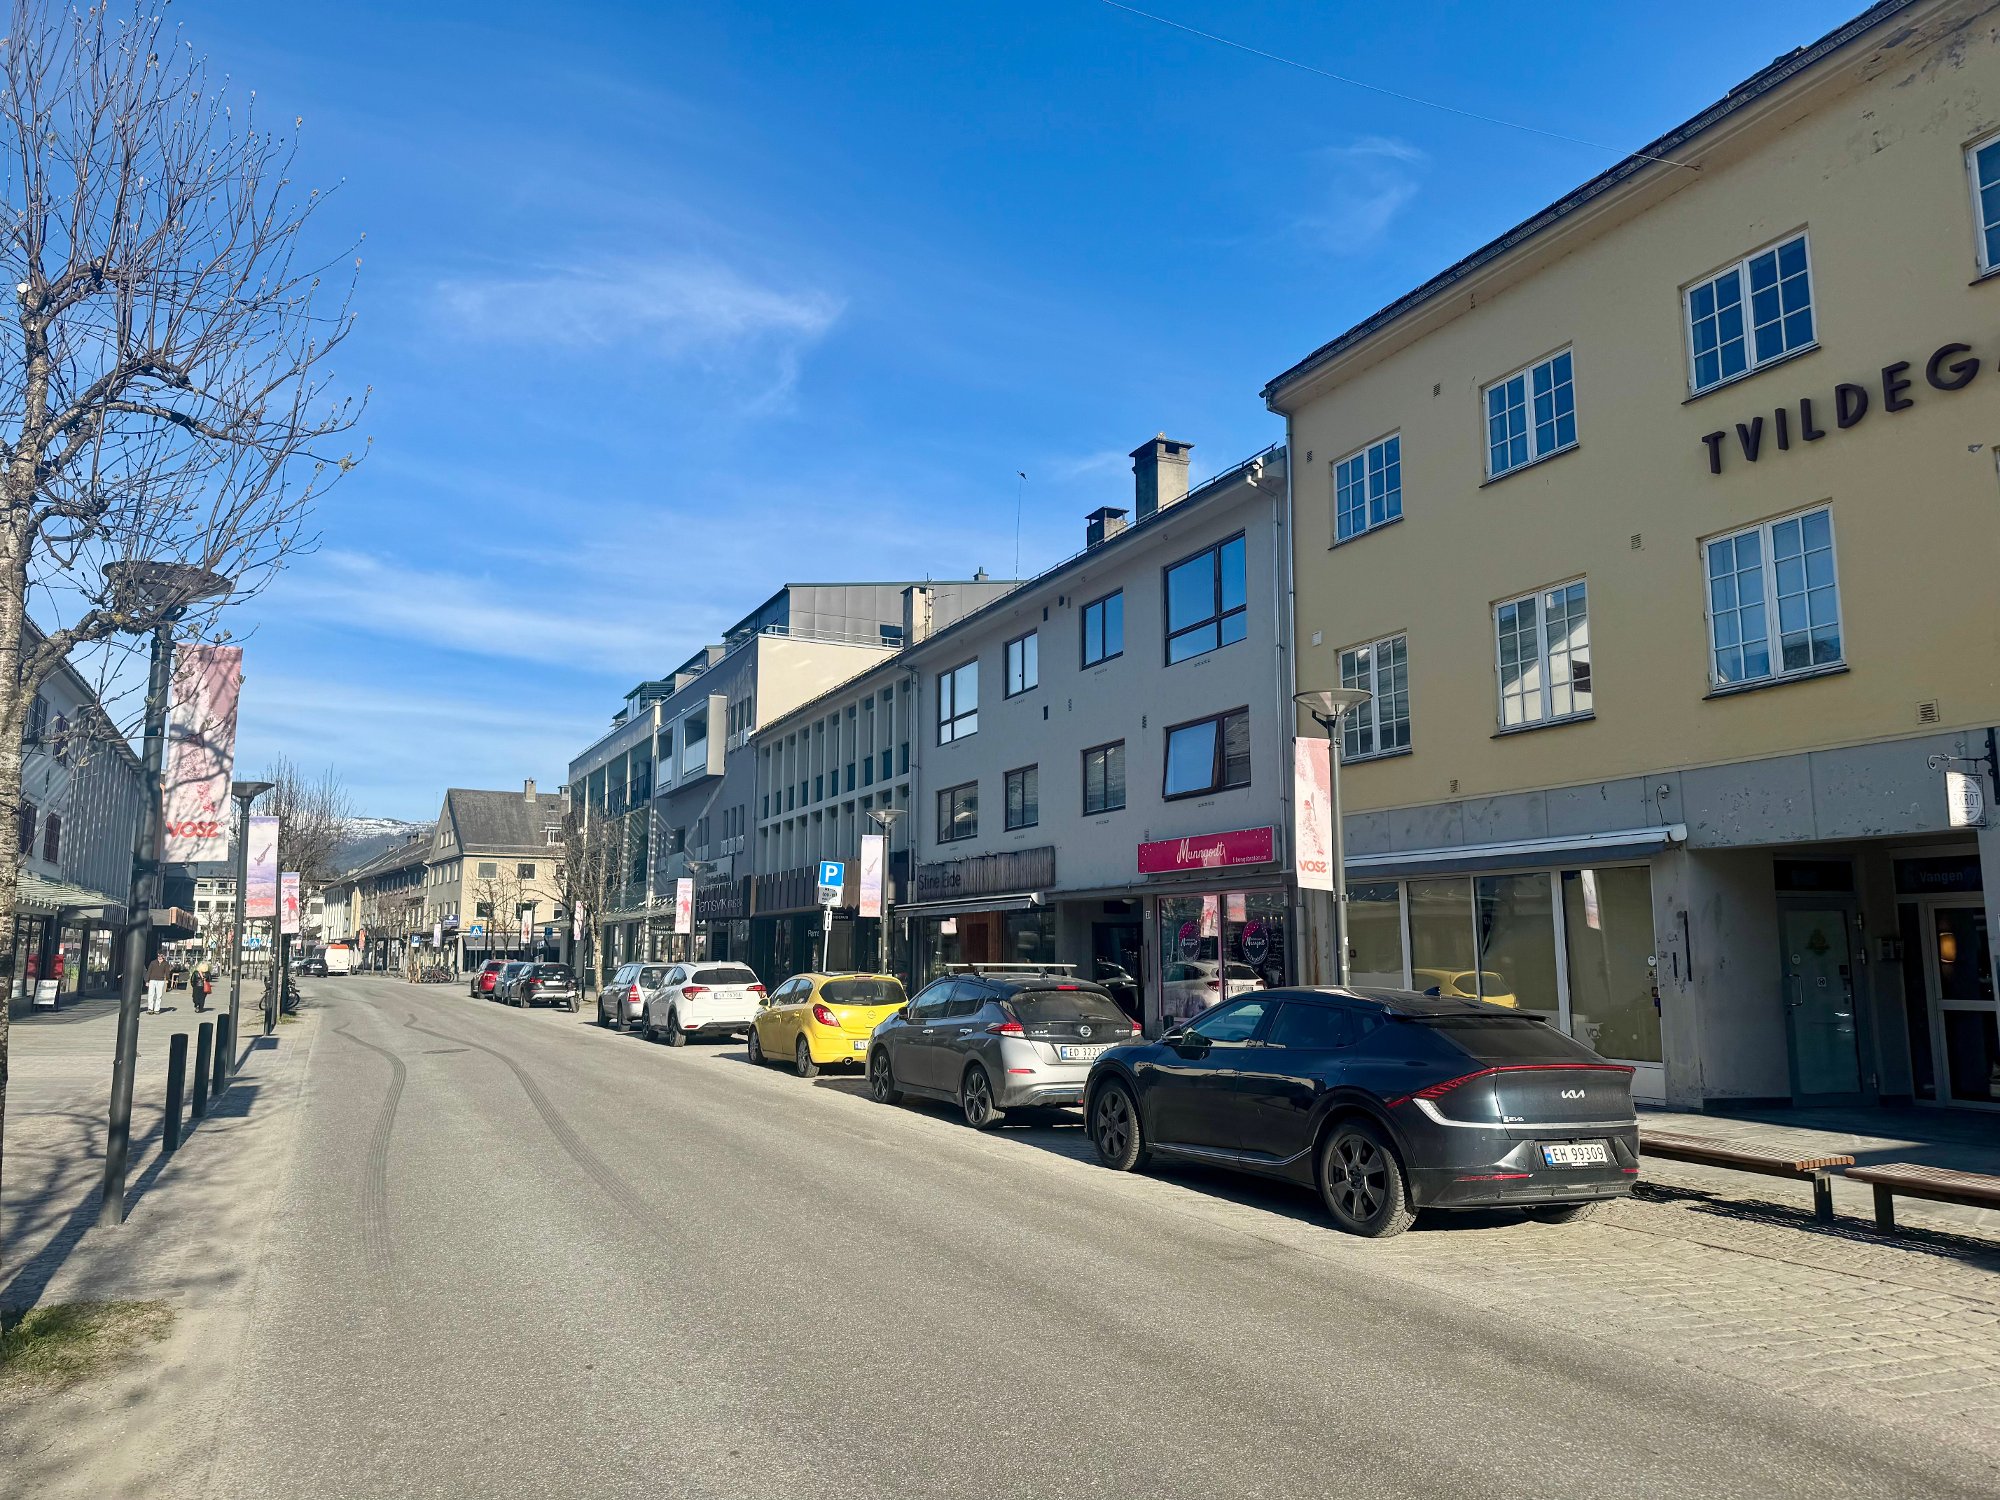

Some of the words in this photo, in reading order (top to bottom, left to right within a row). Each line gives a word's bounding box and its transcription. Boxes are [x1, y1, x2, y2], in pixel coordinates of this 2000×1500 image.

[1702, 343, 2000, 474] TVILDEG
[825, 865, 838, 882] P
[1561, 1089, 1586, 1099] KIA
[1552, 1147, 1568, 1161] EH
[1571, 1146, 1604, 1161] 99309
